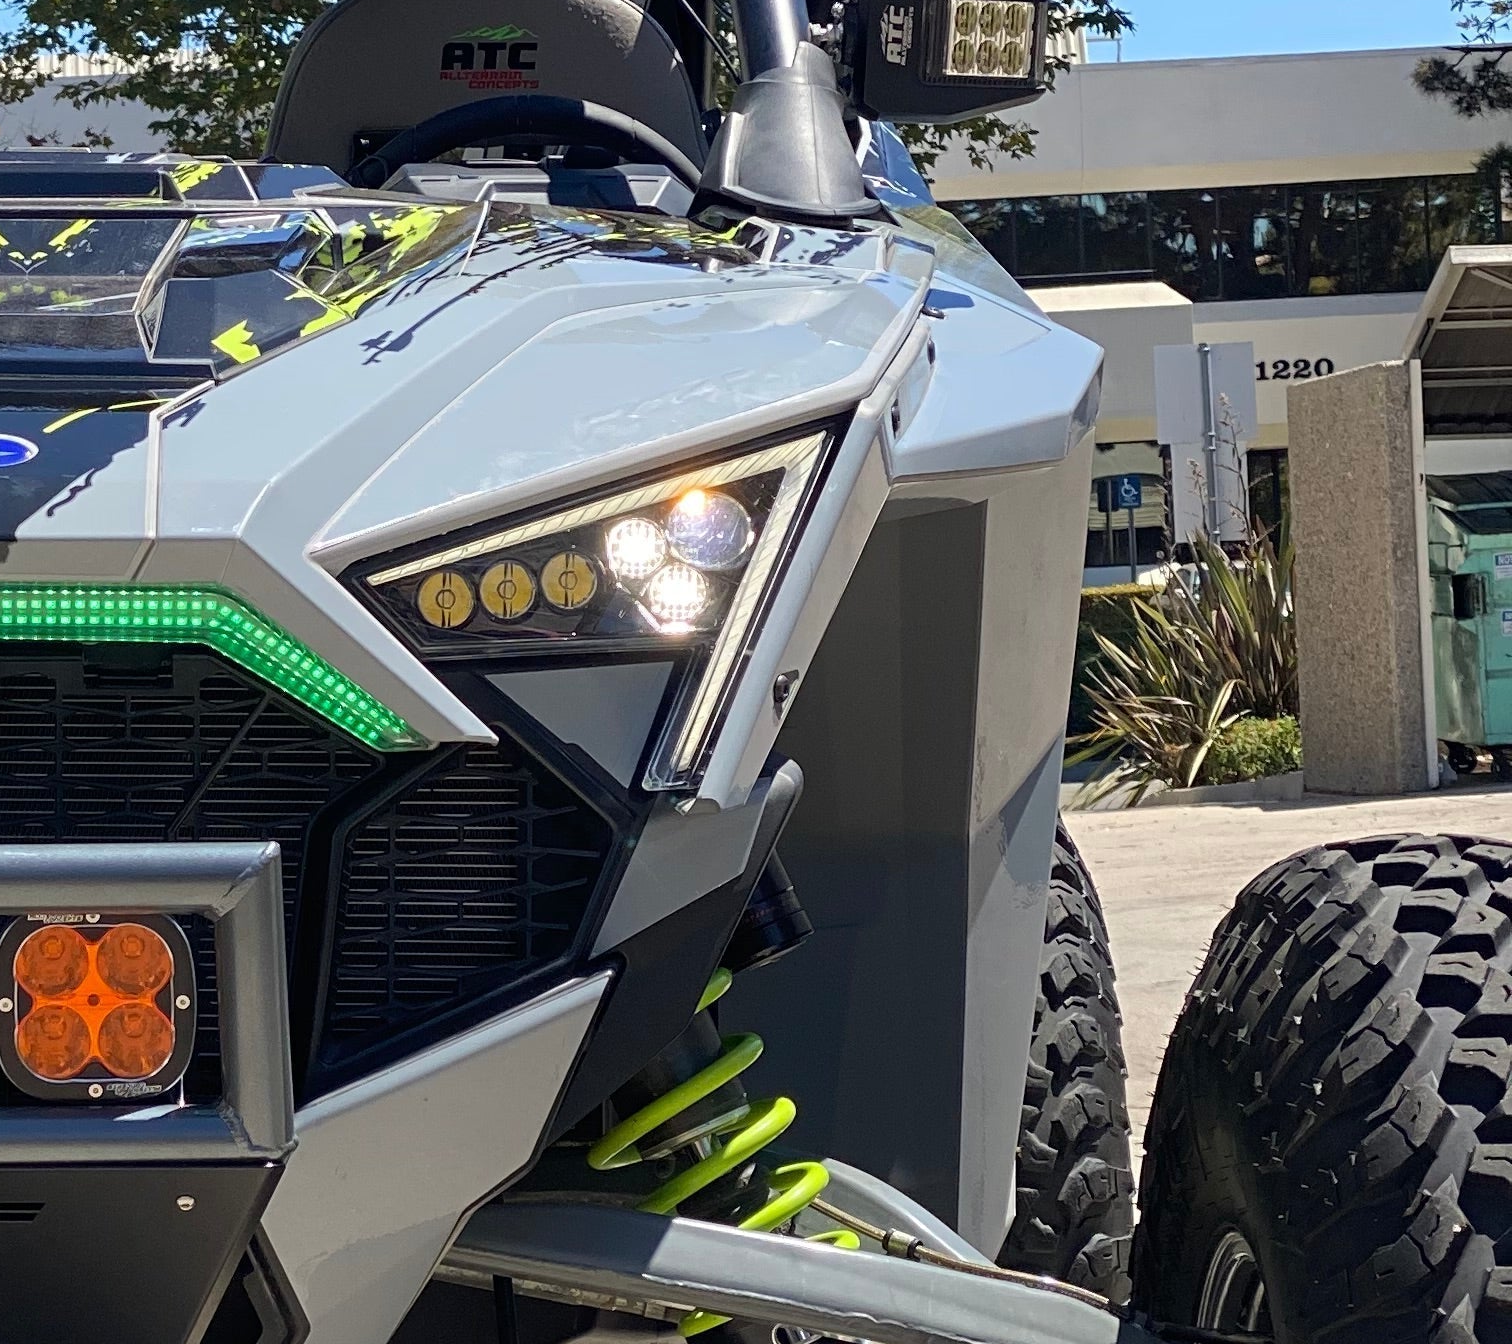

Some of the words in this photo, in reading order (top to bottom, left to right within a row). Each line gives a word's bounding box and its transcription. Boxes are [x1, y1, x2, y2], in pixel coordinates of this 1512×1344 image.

[885, 5, 906, 65] ATC
[440, 42, 538, 70] ATC
[468, 79, 540, 89] CONCEPTS
[1255, 358, 1335, 381] 1220
